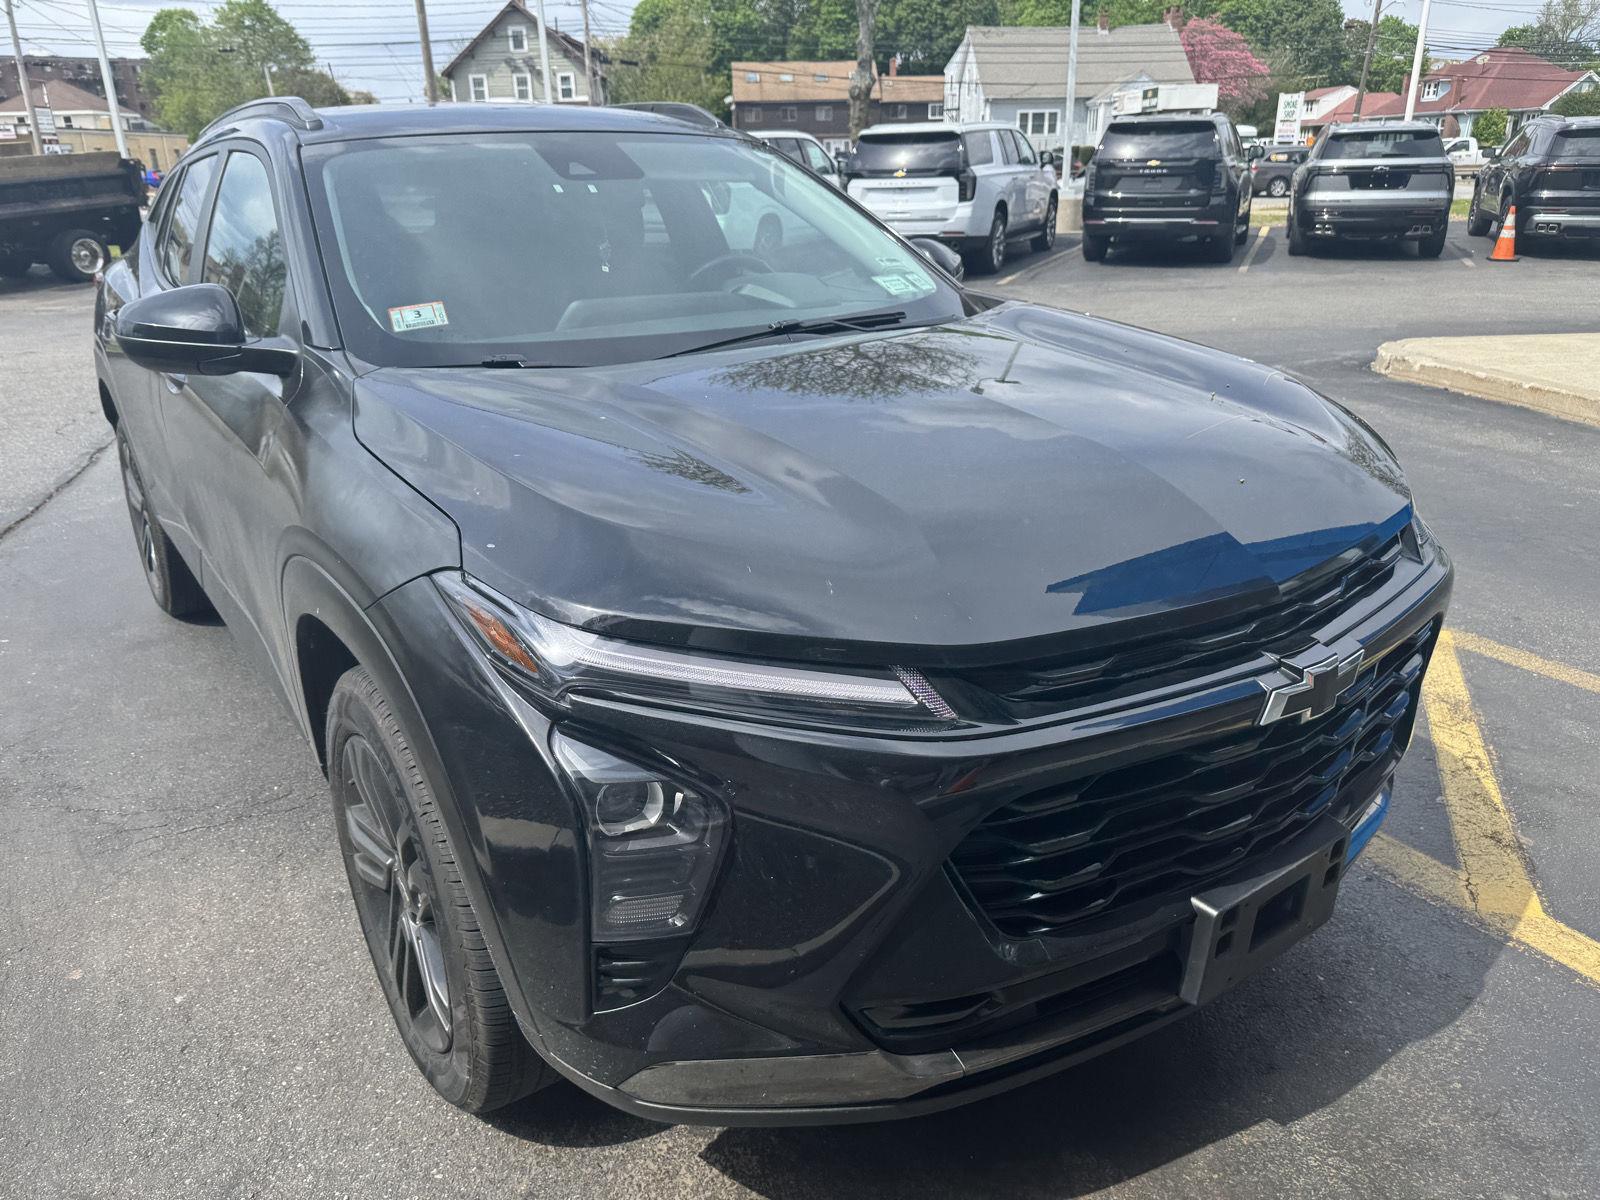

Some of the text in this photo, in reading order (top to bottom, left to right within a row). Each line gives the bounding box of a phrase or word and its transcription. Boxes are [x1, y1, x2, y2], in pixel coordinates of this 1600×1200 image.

[1283, 100, 1298, 109] SMOKE
[1283, 109, 1296, 119] SHOP
[413, 310, 422, 319] 3
